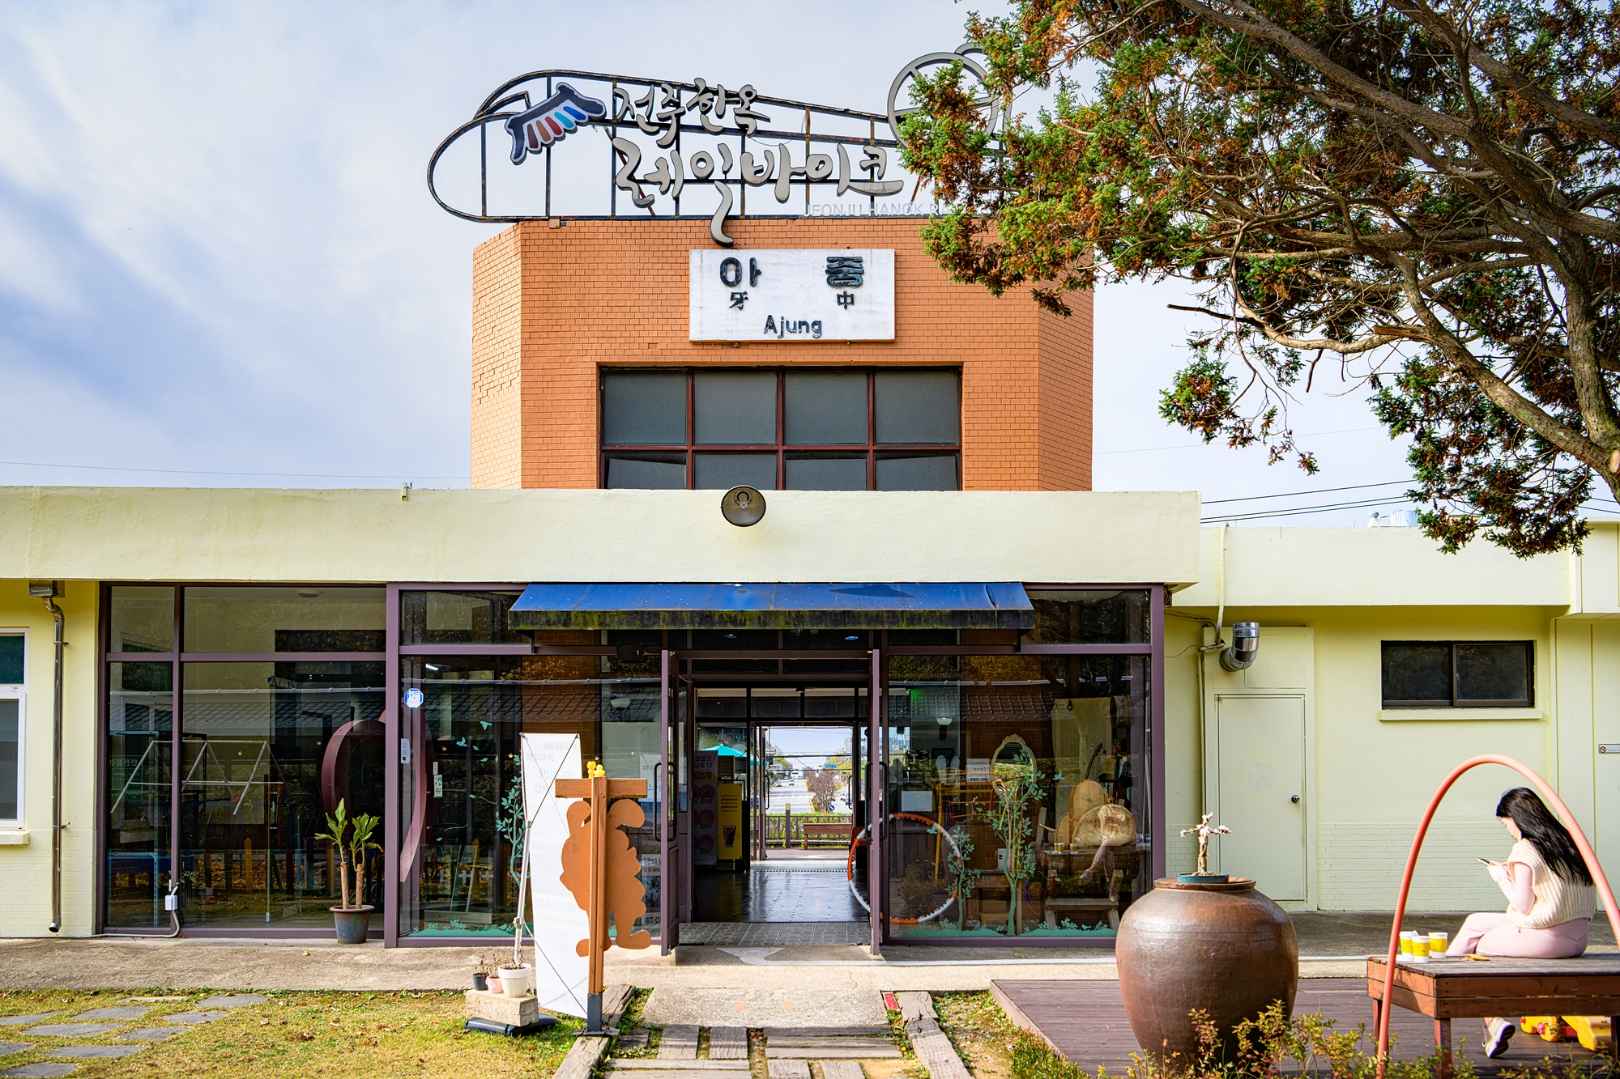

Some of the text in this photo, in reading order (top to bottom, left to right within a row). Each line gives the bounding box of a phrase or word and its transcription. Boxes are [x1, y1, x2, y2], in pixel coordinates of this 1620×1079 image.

[613, 77, 771, 149] 전주한옥
[612, 142, 904, 247] 레일바이크
[763, 314, 823, 338] Ajung
